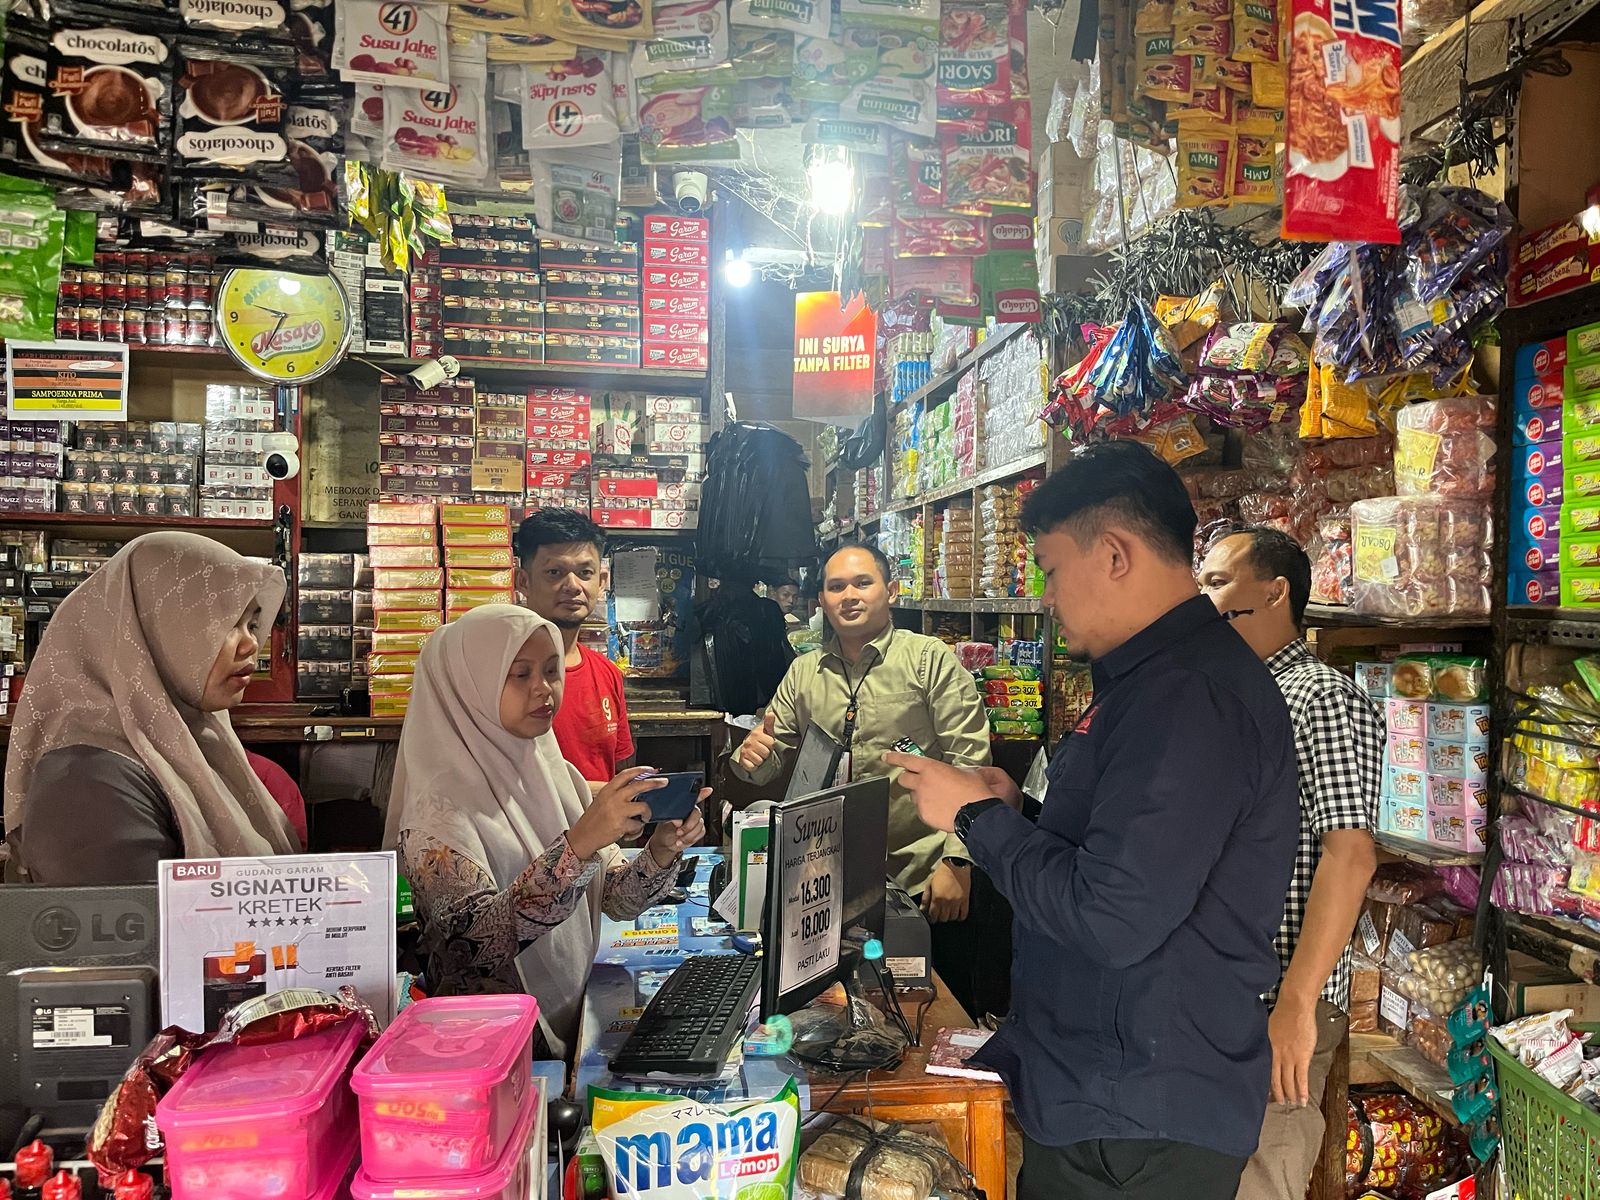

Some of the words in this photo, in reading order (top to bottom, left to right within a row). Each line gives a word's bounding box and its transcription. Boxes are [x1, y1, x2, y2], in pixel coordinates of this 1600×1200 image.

[383, 4, 411, 32] 41
[1247, 5, 1272, 20] AMH
[360, 34, 400, 50] Susu
[402, 38, 437, 55] Jahe
[1149, 41, 1170, 50] AM
[940, 64, 992, 79] SAORI
[530, 85, 559, 100] Jahe
[562, 83, 597, 96] Susu
[862, 98, 918, 120] Promina
[403, 110, 441, 128] Susu
[443, 115, 477, 133] Jahe
[1190, 153, 1218, 167] AMH
[1244, 168, 1269, 180] AMH
[230, 312, 238, 323] 9
[334, 310, 341, 321] 3
[252, 322, 320, 353] Masako
[799, 338, 818, 355] INI
[823, 335, 864, 354] SURYA
[286, 361, 295, 373] 6
[794, 357, 829, 373] TANPA
[834, 354, 870, 371] FILTER
[325, 486, 371, 496] MEROKOK
[1360, 535, 1391, 551] OSCAR
[1023, 686, 1035, 694] 30%
[1024, 699, 1037, 707] 30%
[793, 815, 837, 849] Surya
[785, 855, 805, 869] HARGA
[807, 844, 841, 862] TERJANGKAU
[177, 865, 217, 877] BARU
[236, 868, 282, 877] GUDANG
[287, 866, 324, 875] GARAM
[210, 877, 349, 898] SIGNATURE
[801, 873, 831, 906] 16.300
[238, 897, 322, 915] KRETEK
[92, 912, 144, 941] LG
[801, 908, 831, 941] 18.000
[797, 955, 814, 971] PASTI
[815, 947, 830, 963] LAKU
[596, 1104, 614, 1112] LION
[616, 1111, 779, 1194] mama
[720, 1157, 777, 1176] Lemon
